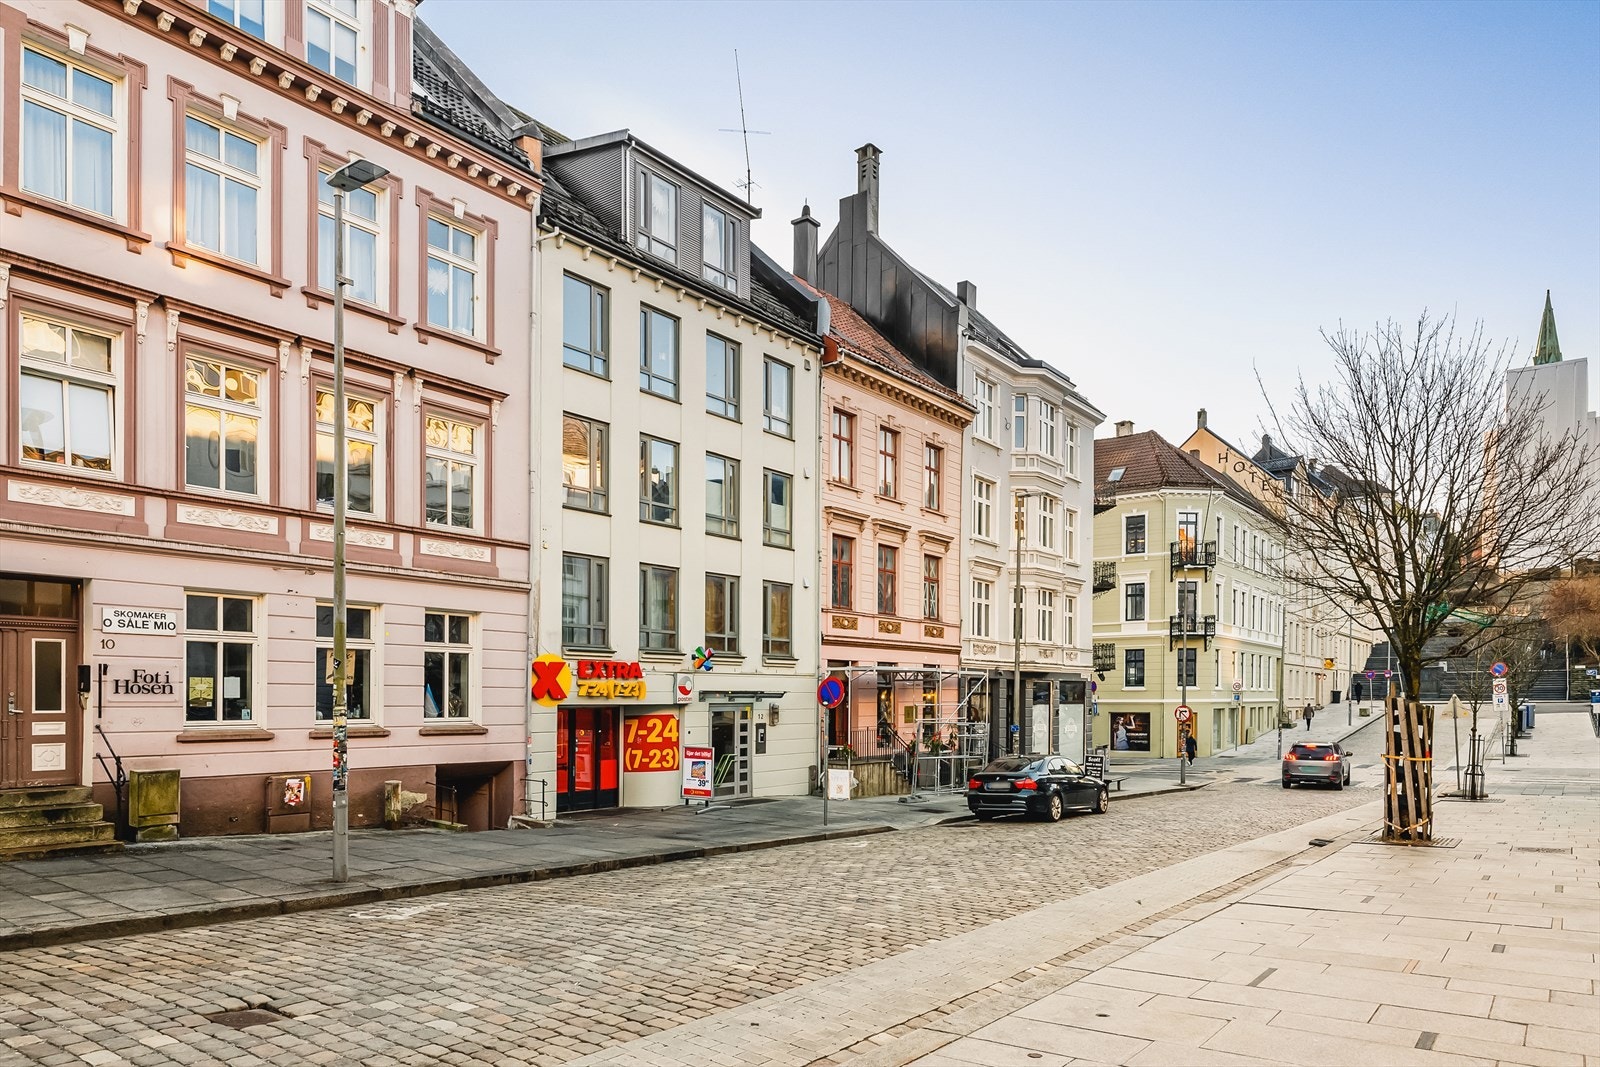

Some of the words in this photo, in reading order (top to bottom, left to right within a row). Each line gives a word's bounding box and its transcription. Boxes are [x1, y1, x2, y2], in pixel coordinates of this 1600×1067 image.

[113, 609, 167, 620] SKOMAKER
[103, 618, 112, 627] O
[153, 621, 176, 631] MIO
[100, 638, 116, 649] 10
[132, 668, 161, 684] Fot
[164, 670, 170, 684] i
[577, 660, 644, 679] EXTRA
[113, 679, 174, 695] Hosen
[531, 661, 568, 700] X
[577, 680, 609, 697] 7-24
[625, 718, 679, 743] 7-24
[625, 746, 679, 771] (7-23)
